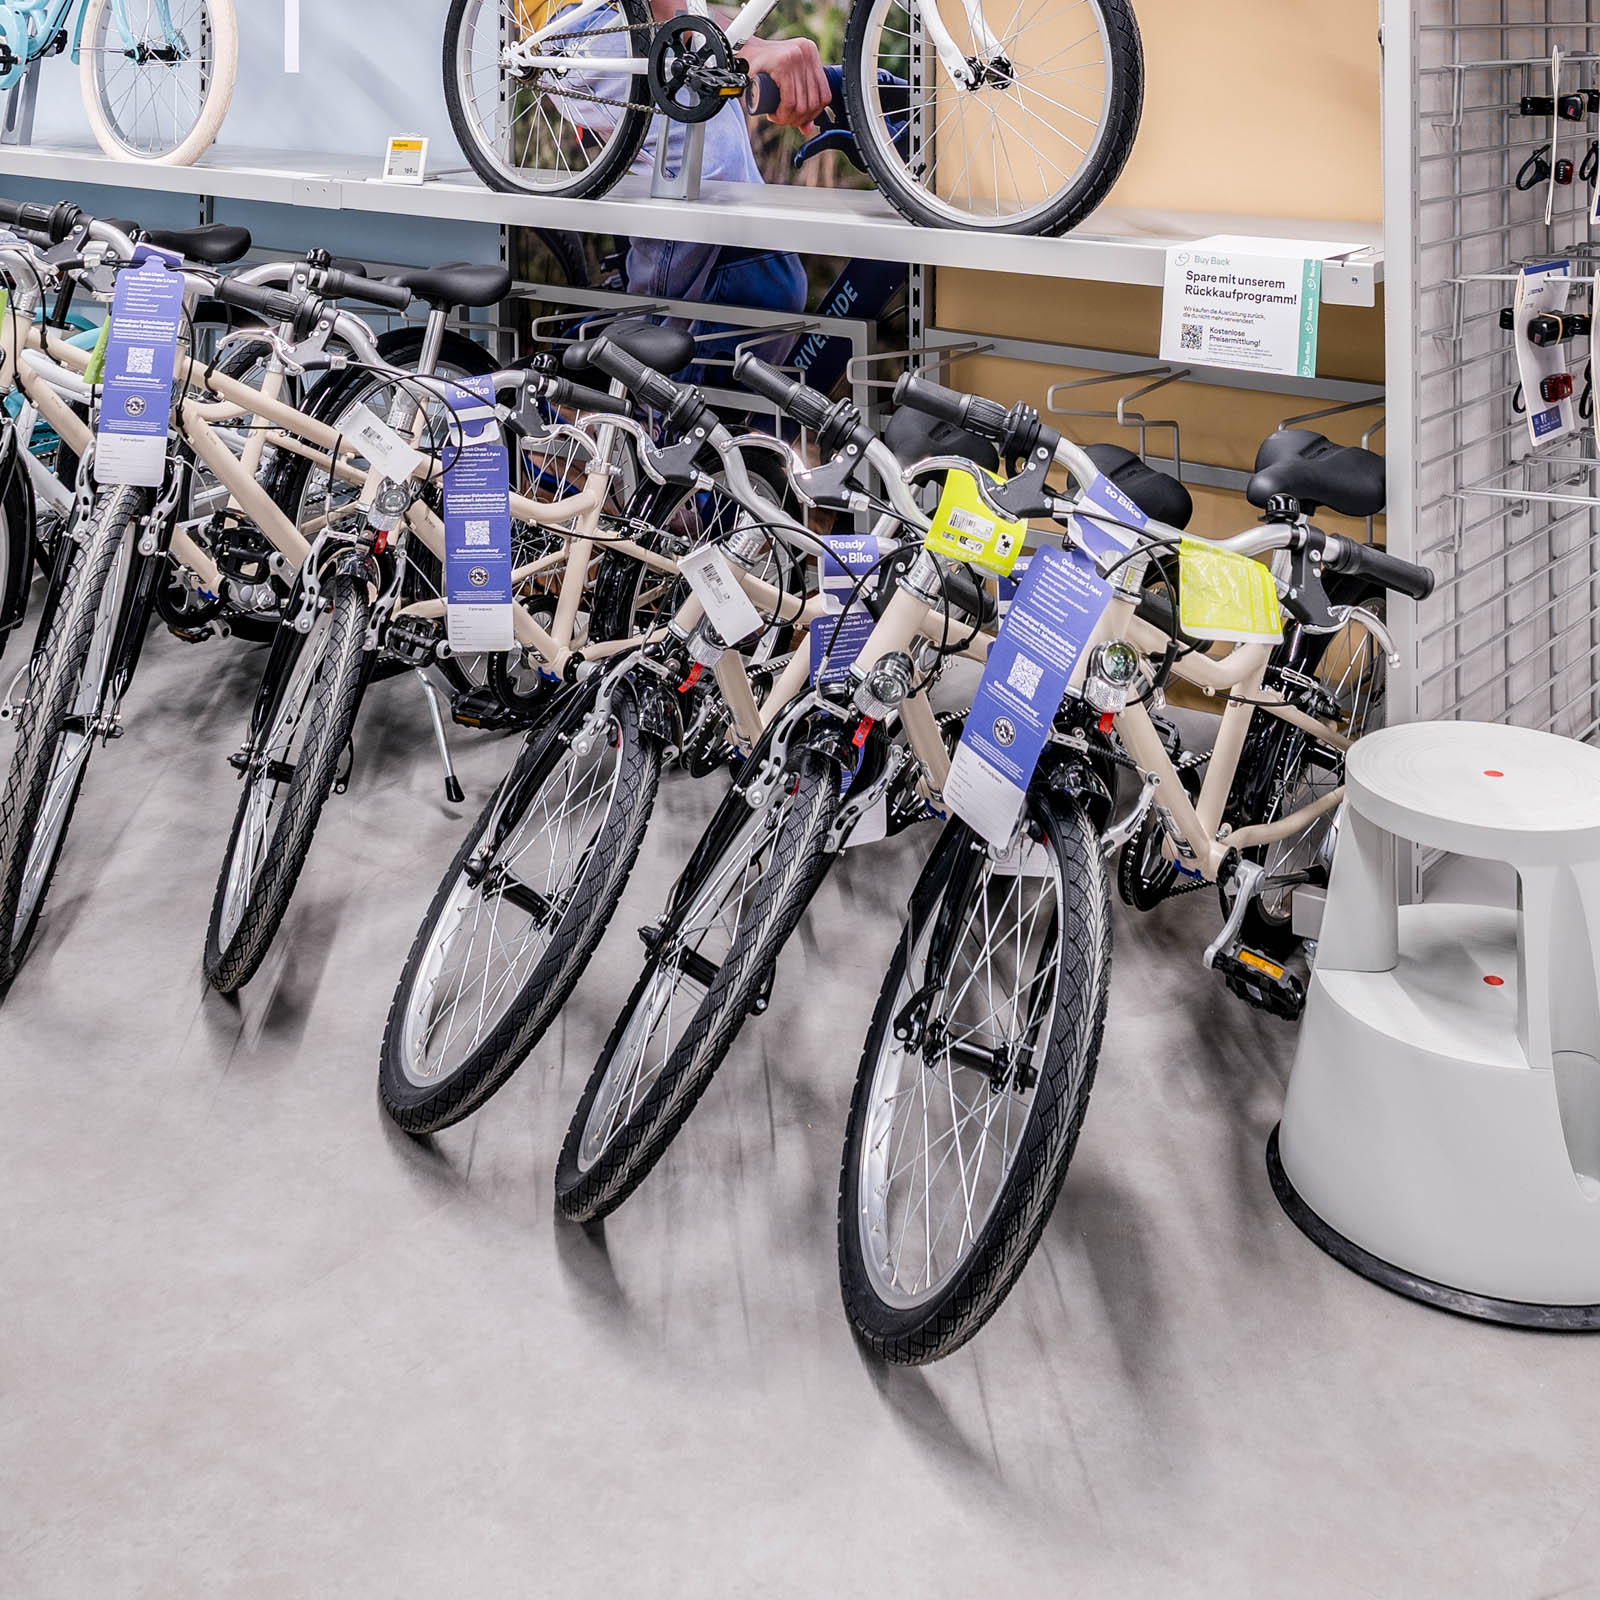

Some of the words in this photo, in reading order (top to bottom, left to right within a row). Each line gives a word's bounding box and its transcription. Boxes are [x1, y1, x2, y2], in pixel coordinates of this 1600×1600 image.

[1195, 256, 1209, 265] Buy
[1211, 257, 1230, 266] Back
[1186, 271, 1217, 283] Spare
[1219, 274, 1235, 284] mit
[1238, 278, 1285, 289] unserem
[1185, 285, 1297, 305] Rückkaufprogramm!
[1219, 310, 1246, 318] Ausrüstung
[794, 280, 858, 370] RIVEIDE
[1209, 326, 1245, 337] Kostenlose
[1208, 335, 1261, 348] Preisermittlung!
[1105, 485, 1118, 500] to
[1117, 495, 1142, 520] Bike
[830, 539, 866, 551] Ready
[848, 552, 874, 564] Bike
